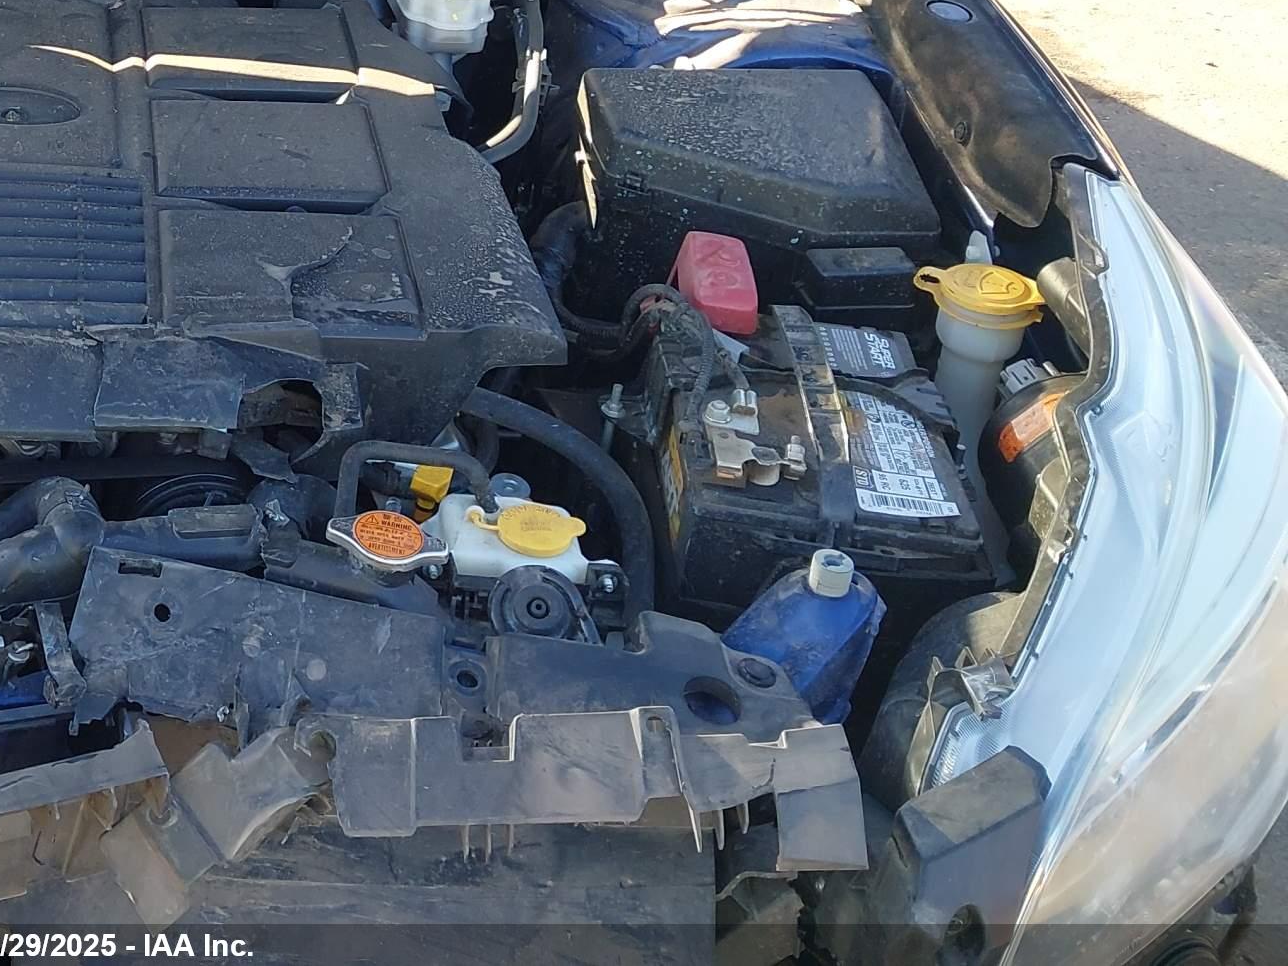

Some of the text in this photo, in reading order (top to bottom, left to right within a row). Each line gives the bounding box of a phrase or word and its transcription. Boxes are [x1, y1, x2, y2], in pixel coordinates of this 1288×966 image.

[864, 331, 886, 369] START
[879, 338, 896, 370] SUPER
[381, 520, 413, 531] WARNING
